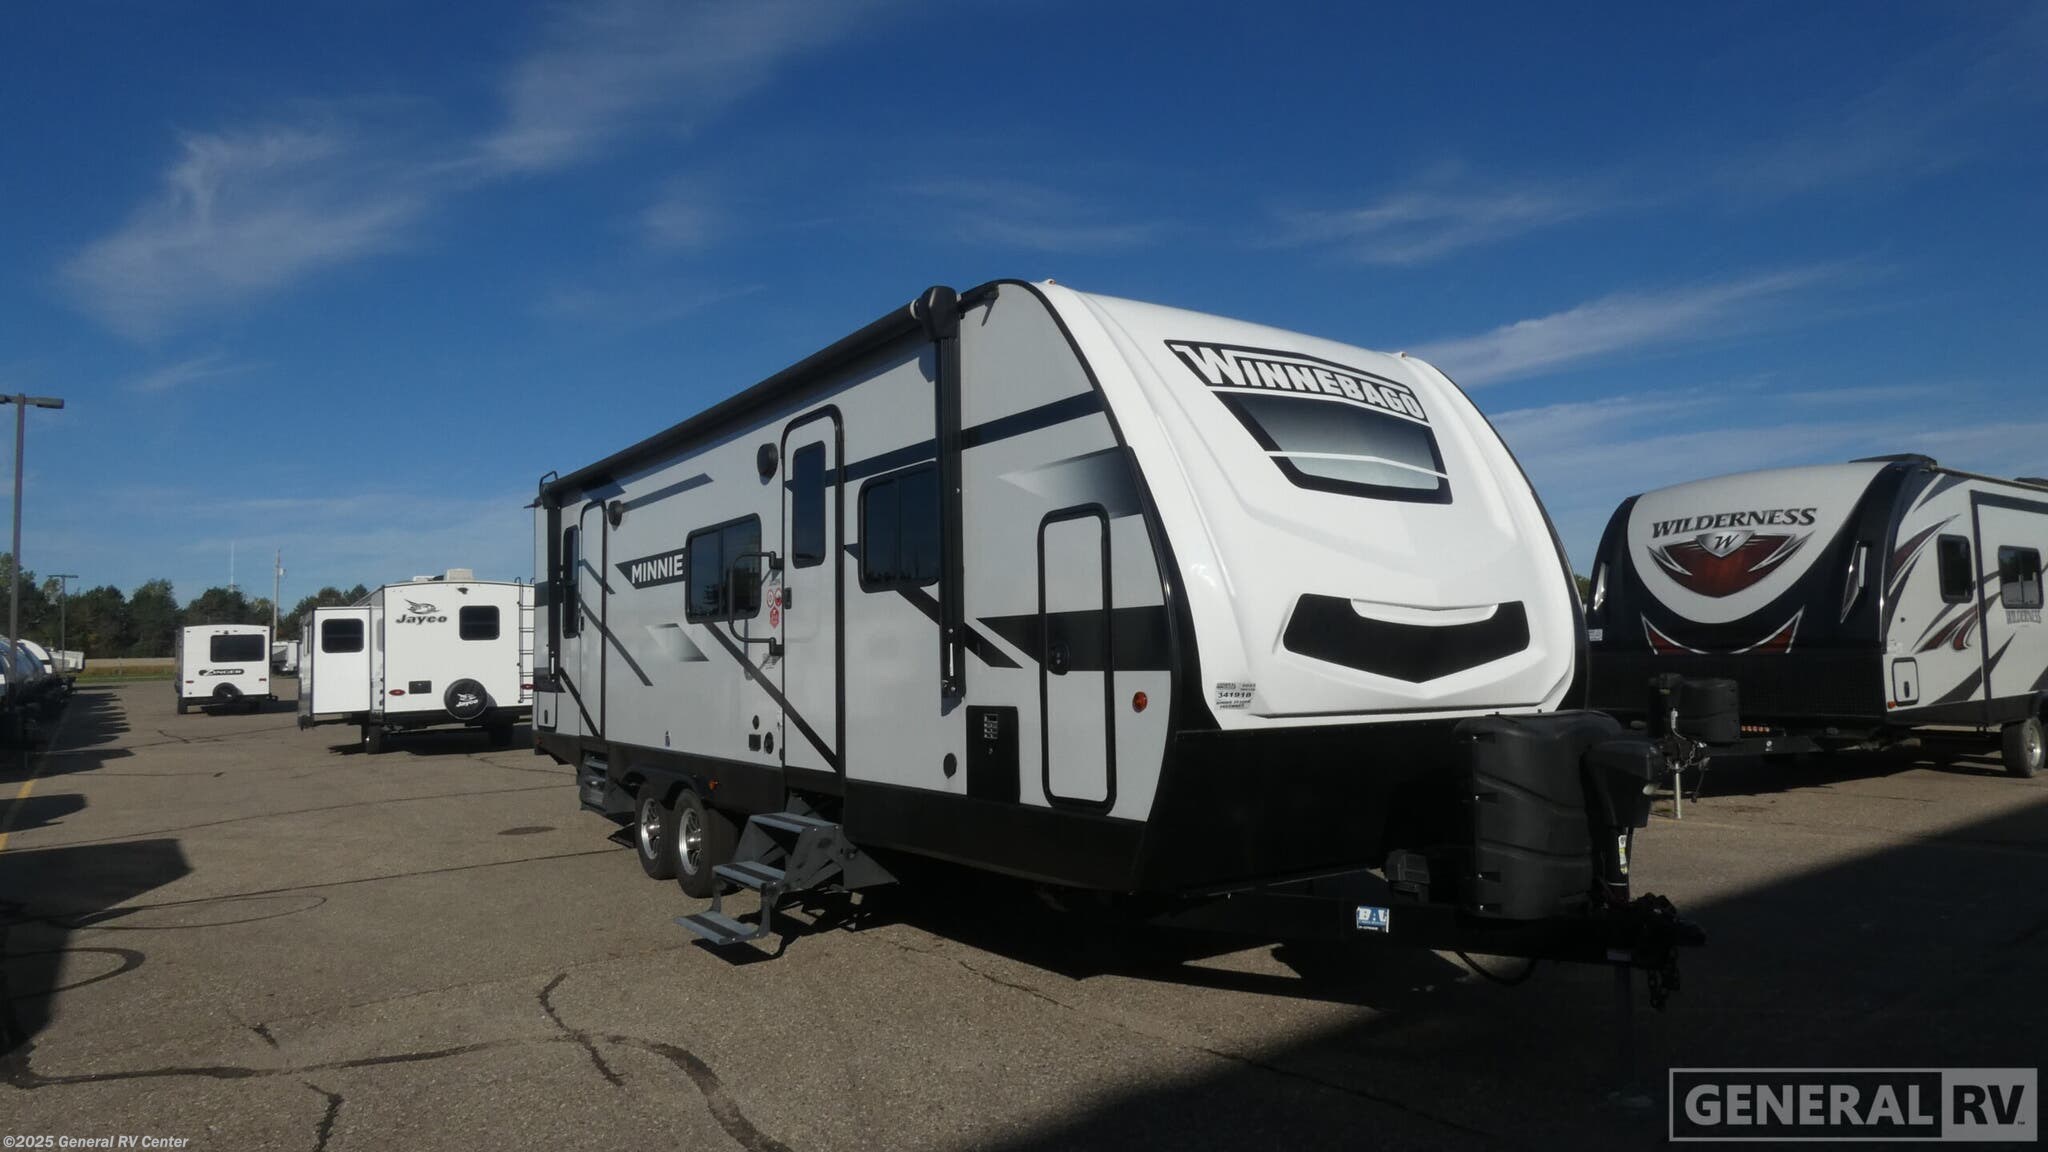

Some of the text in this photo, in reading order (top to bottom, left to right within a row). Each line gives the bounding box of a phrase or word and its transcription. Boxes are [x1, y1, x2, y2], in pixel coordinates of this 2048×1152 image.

[1169, 343, 1426, 420] WINNEBAGO
[1652, 507, 1818, 539] WILDERNESS
[631, 554, 684, 584] MINNIE
[395, 614, 448, 626] Jayco
[455, 699, 479, 708] Jayco
